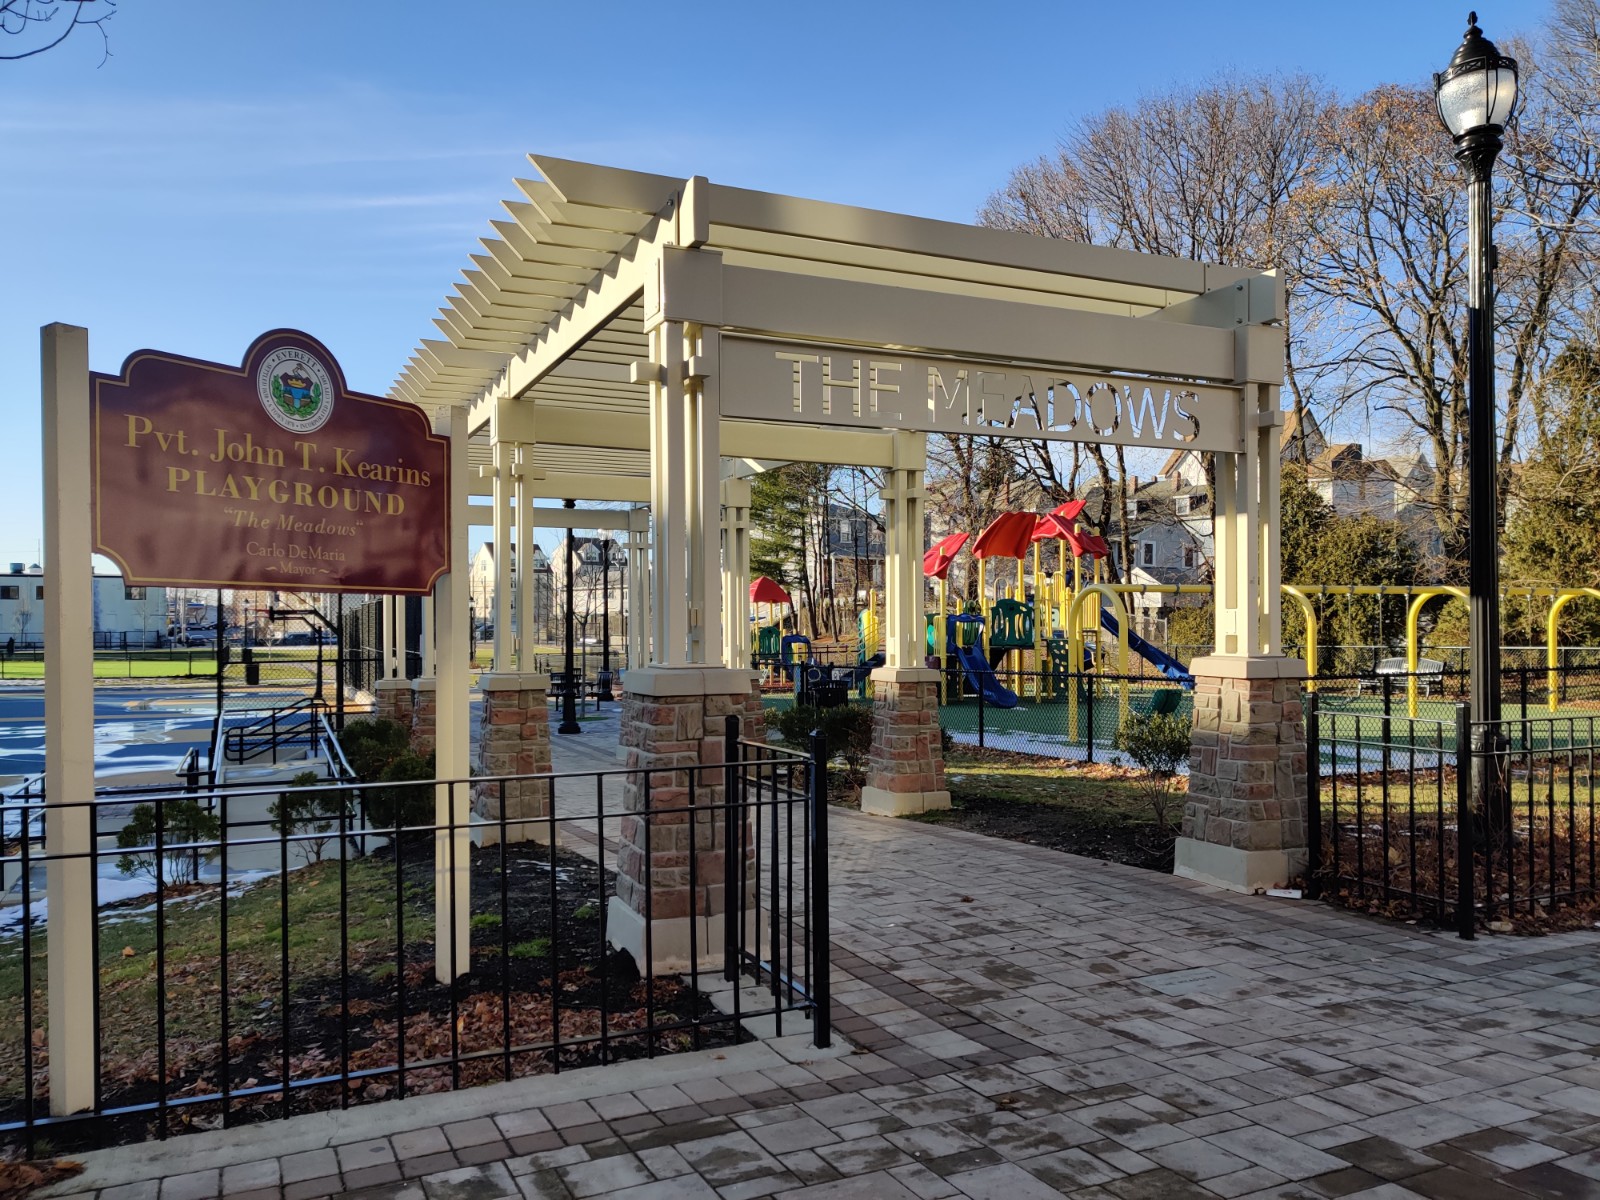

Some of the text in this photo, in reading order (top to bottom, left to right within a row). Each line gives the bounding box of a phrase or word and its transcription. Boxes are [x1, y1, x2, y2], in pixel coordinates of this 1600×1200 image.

[275, 351, 317, 368] EVERETT
[775, 352, 1200, 443] THE MEADOWS
[270, 408, 285, 423] TOWN
[124, 414, 431, 487] Pvt. John T. Kearins
[166, 466, 405, 516] PLAYGROUND
[246, 541, 345, 561] Carlo DeMaria
[280, 562, 317, 576] Mayor
